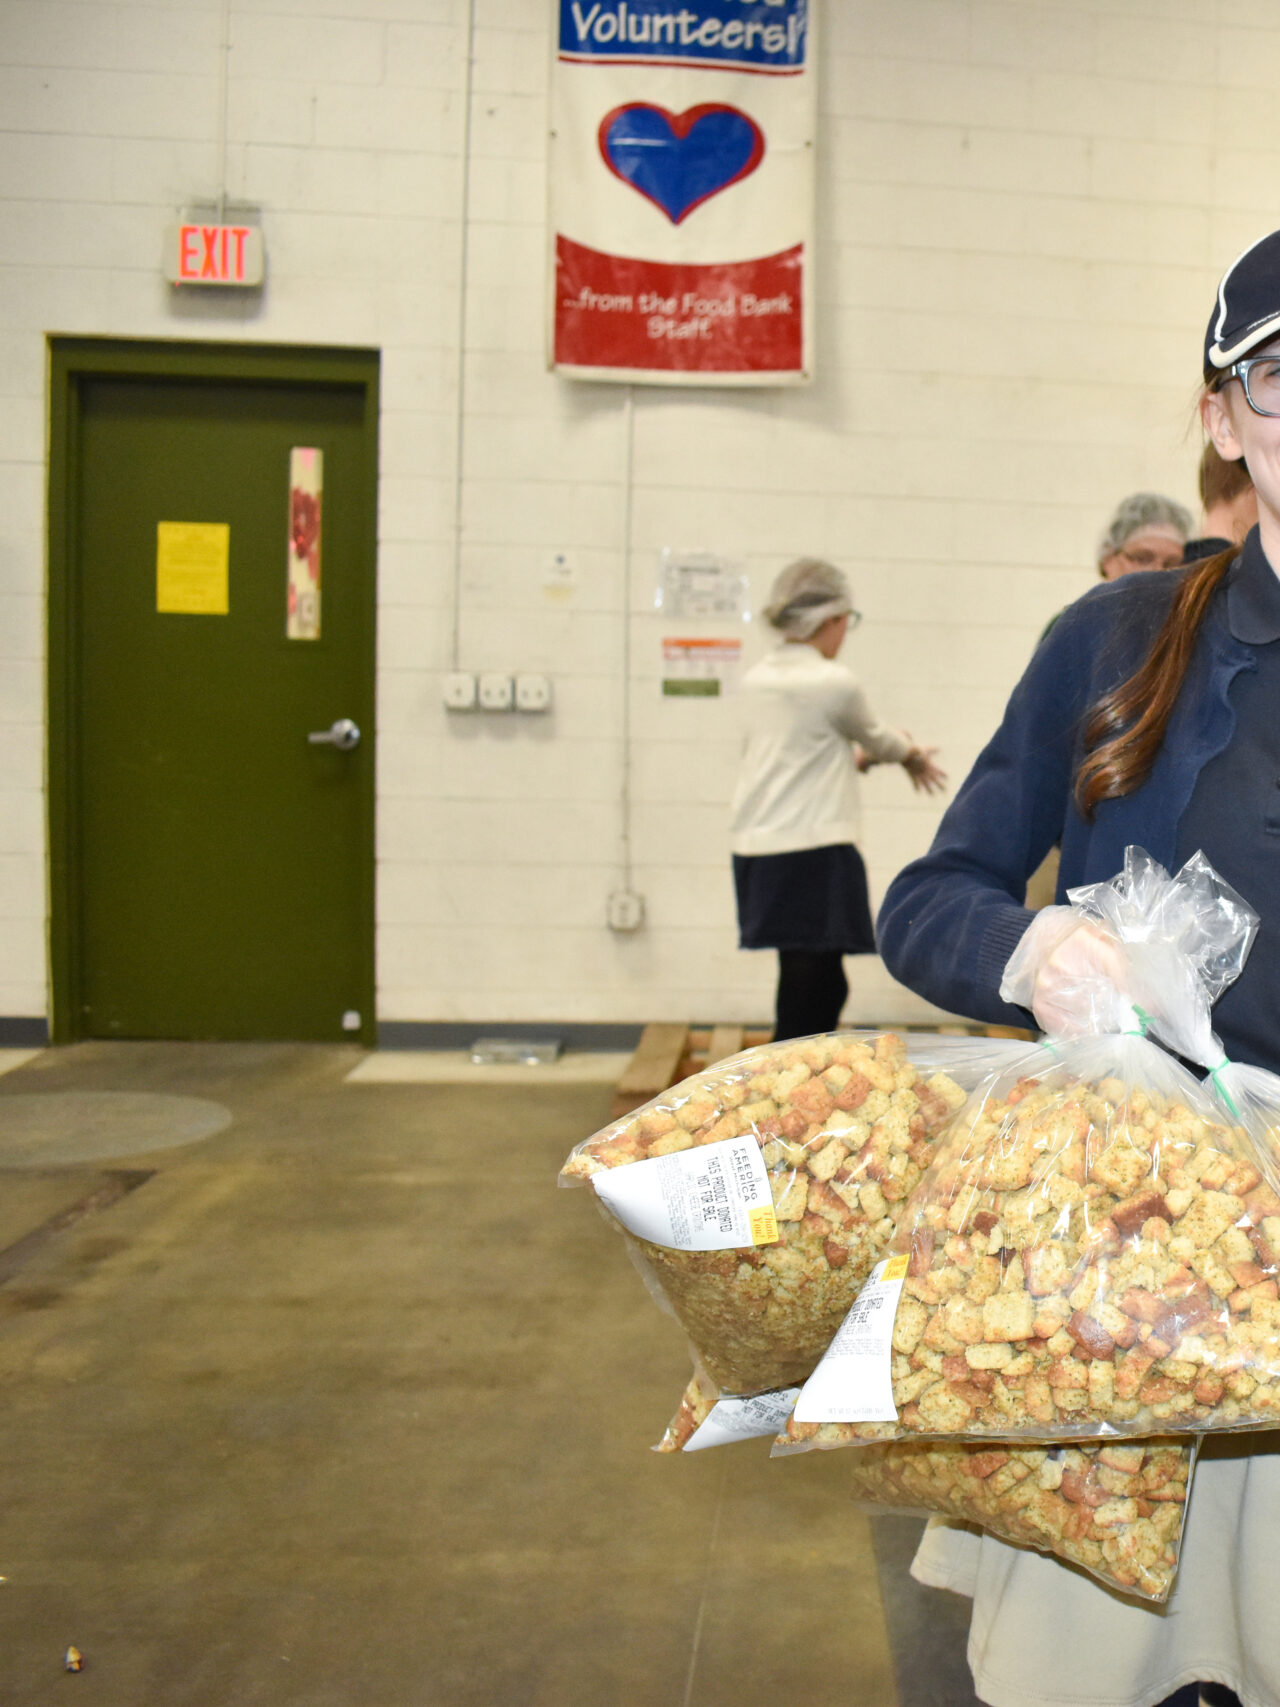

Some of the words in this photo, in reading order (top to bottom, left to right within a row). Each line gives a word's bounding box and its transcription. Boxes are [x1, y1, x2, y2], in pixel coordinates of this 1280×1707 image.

[571, 1, 796, 55] Volunteers!
[179, 225, 250, 282] EXIT
[638, 291, 677, 314] the
[682, 292, 735, 317] Food
[740, 291, 794, 317] Bank
[707, 1157, 722, 1175] THIS
[731, 1149, 750, 1202] AMERICA
[739, 1147, 759, 1200] FEEDING
[697, 1174, 710, 1188] NOT
[712, 1176, 729, 1204] PRODUCT
[700, 1190, 714, 1204] FOR
[702, 1205, 717, 1221] SALE
[717, 1206, 733, 1232] DONATED
[763, 1212, 777, 1239] Thank
[753, 1217, 765, 1238] You!
[751, 1399, 775, 1414] PRODUCT
[753, 1411, 764, 1419] FOR
